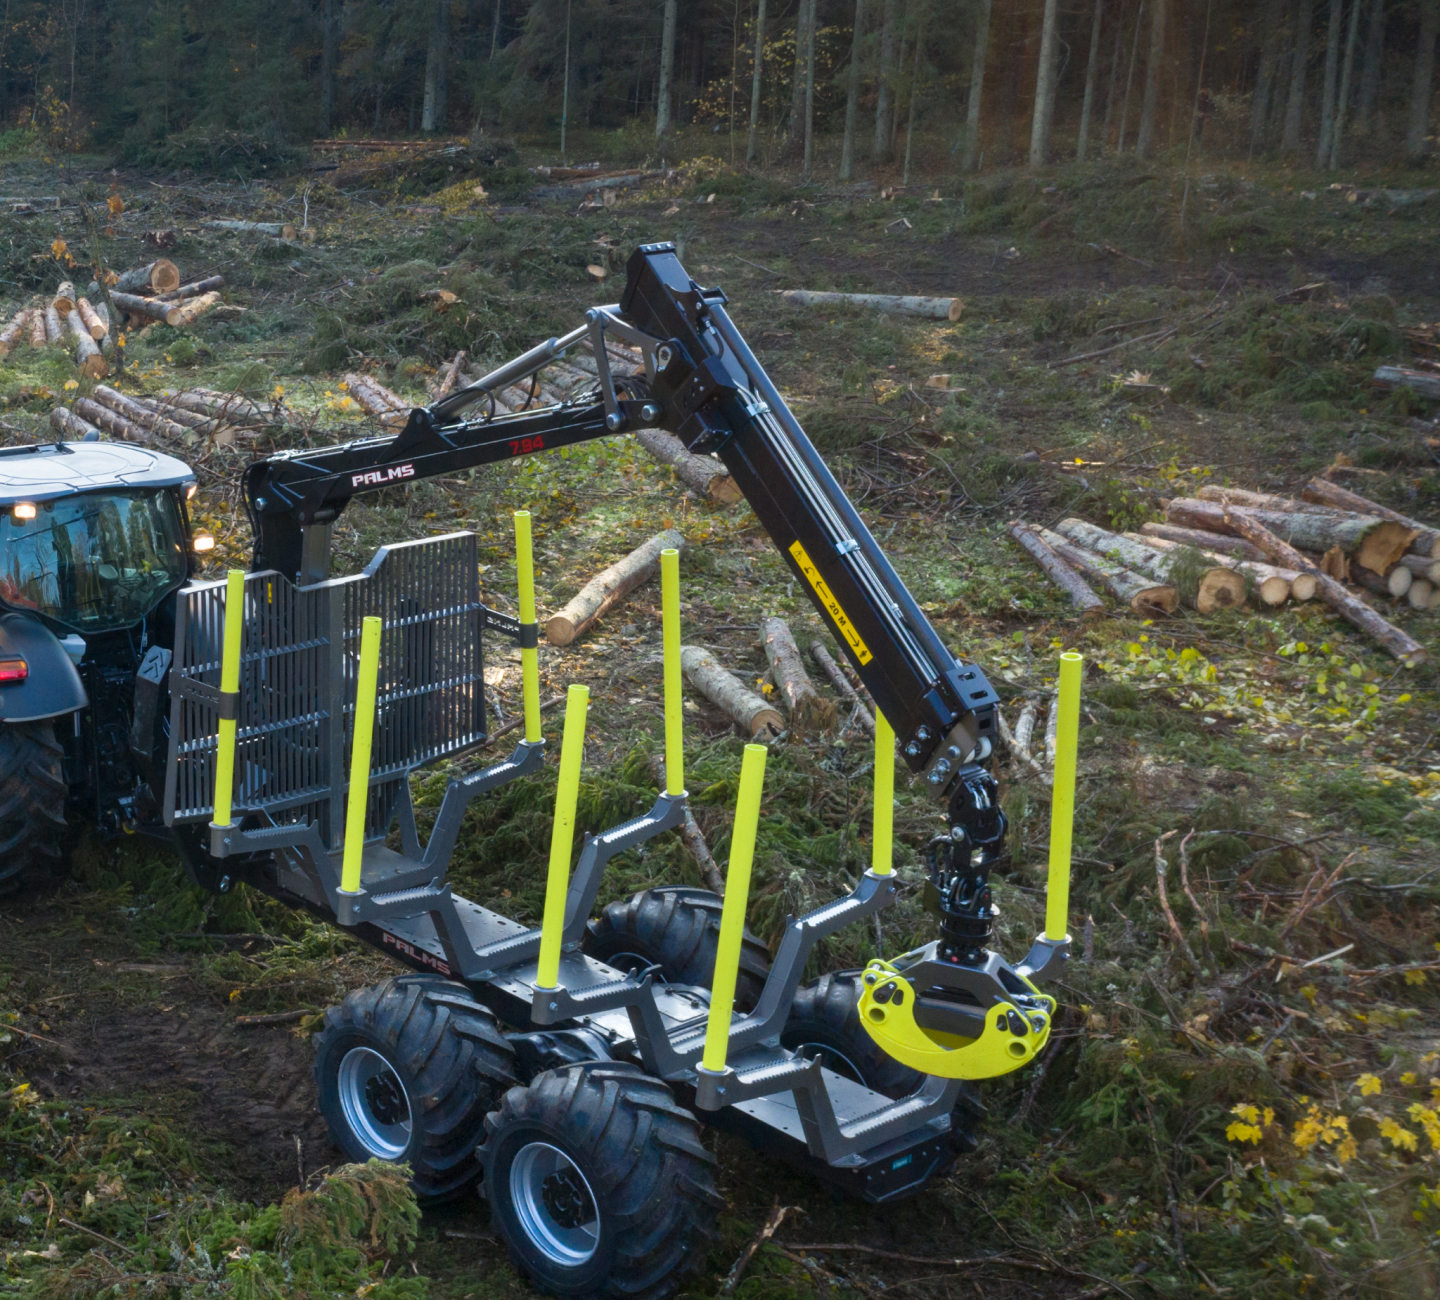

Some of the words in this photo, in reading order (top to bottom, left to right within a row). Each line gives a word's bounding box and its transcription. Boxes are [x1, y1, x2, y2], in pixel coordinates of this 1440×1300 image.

[509, 435, 545, 455] 7.94
[351, 463, 415, 488] PALMS
[828, 602, 840, 616] 20
[382, 931, 452, 976] PALMS
